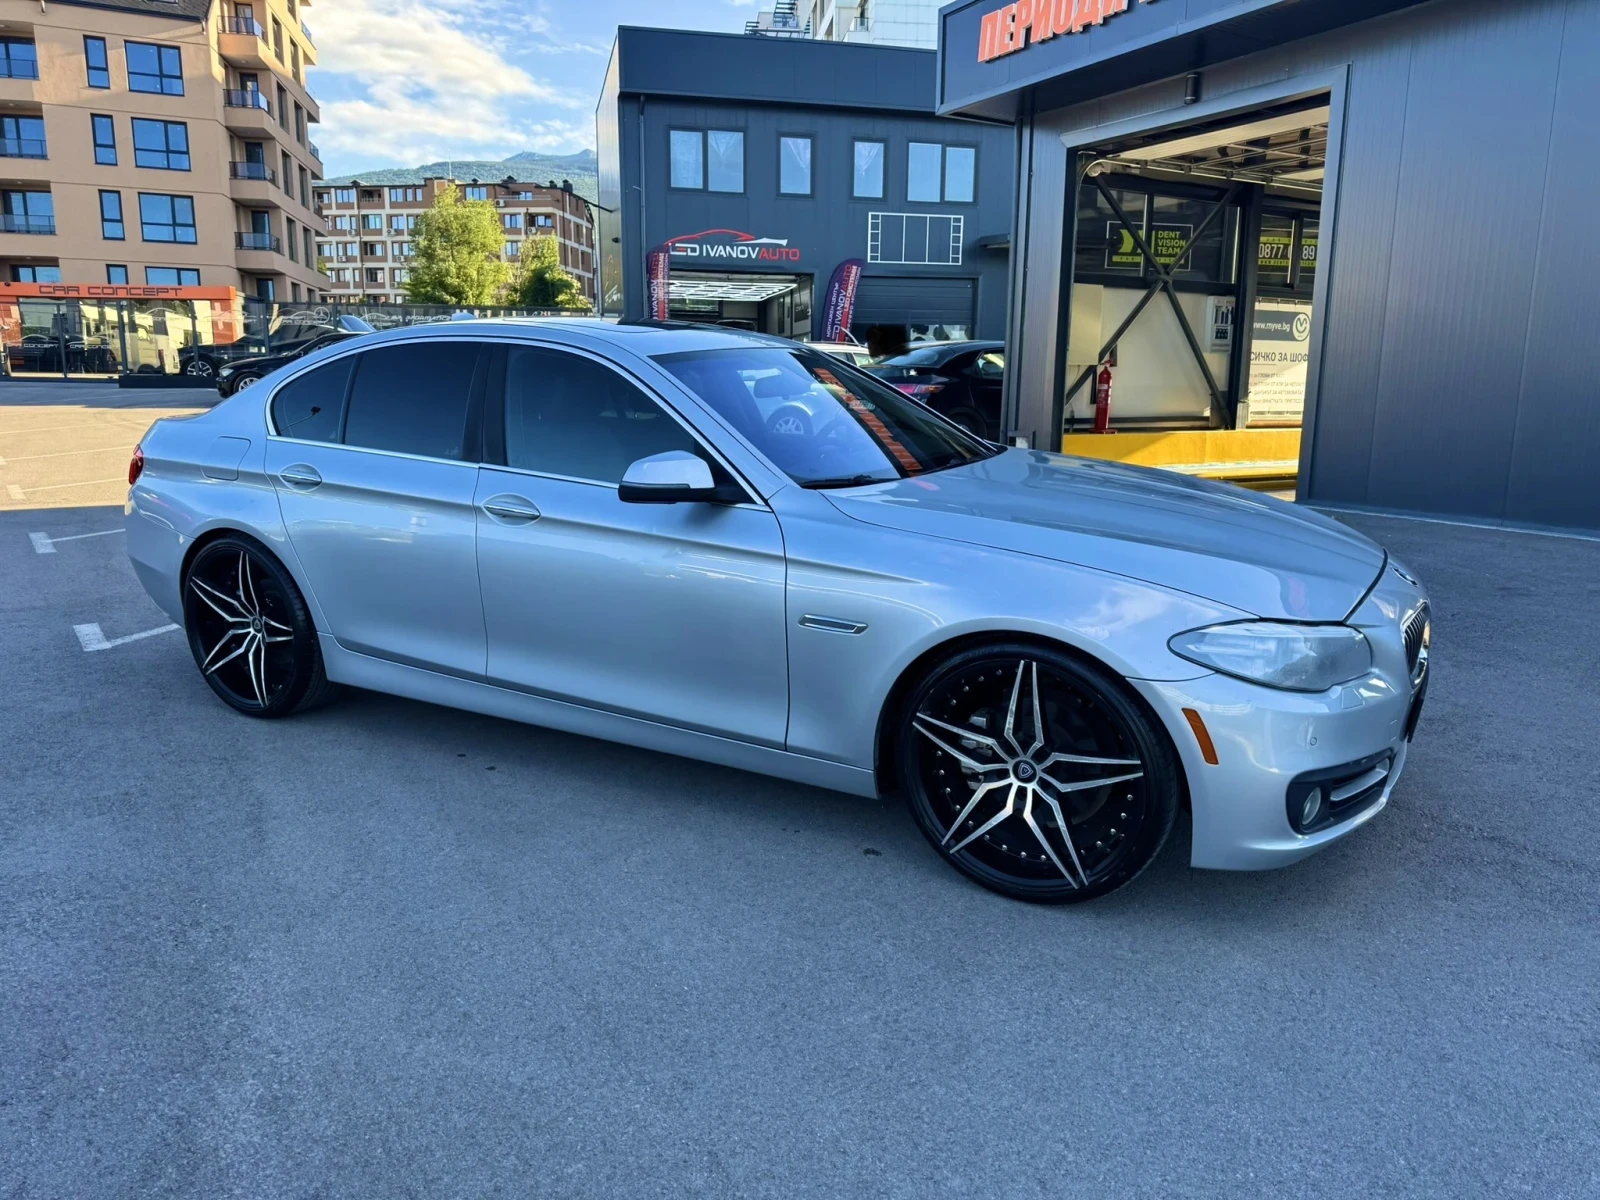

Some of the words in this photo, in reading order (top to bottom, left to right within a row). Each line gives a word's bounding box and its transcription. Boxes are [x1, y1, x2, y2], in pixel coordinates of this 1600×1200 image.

[977, 0, 1146, 63] ПЕРИОД
[1157, 230, 1181, 239] DENT
[1157, 239, 1186, 247] VISION
[1157, 246, 1182, 255] TEAM
[1258, 243, 1284, 259] 0877
[39, 285, 81, 296] CAR
[87, 286, 183, 297] CONCEPT
[1250, 351, 1277, 362] СИЧКО
[1277, 352, 1289, 362] ЗА
